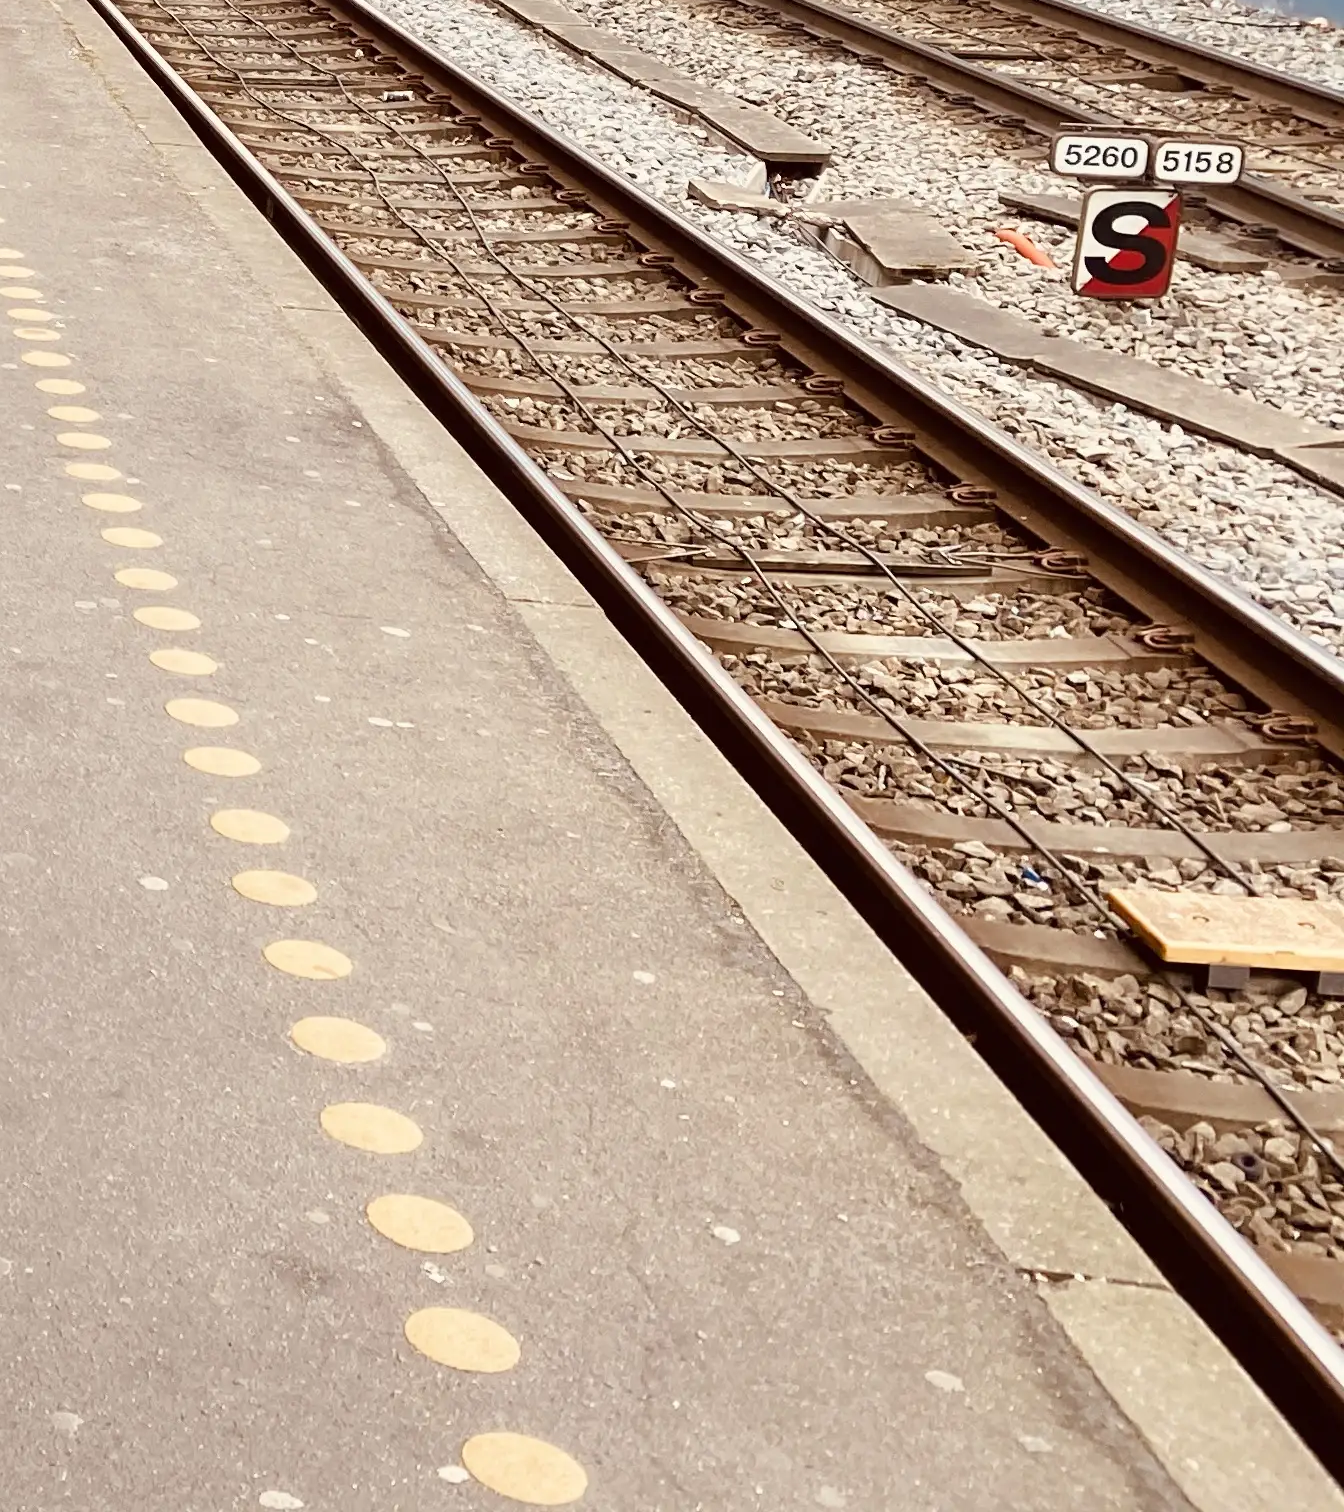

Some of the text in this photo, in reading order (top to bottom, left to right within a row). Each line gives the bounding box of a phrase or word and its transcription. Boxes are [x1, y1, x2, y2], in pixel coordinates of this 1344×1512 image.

[1063, 143, 1234, 174] 5260 5158
[1083, 200, 1172, 286] S
